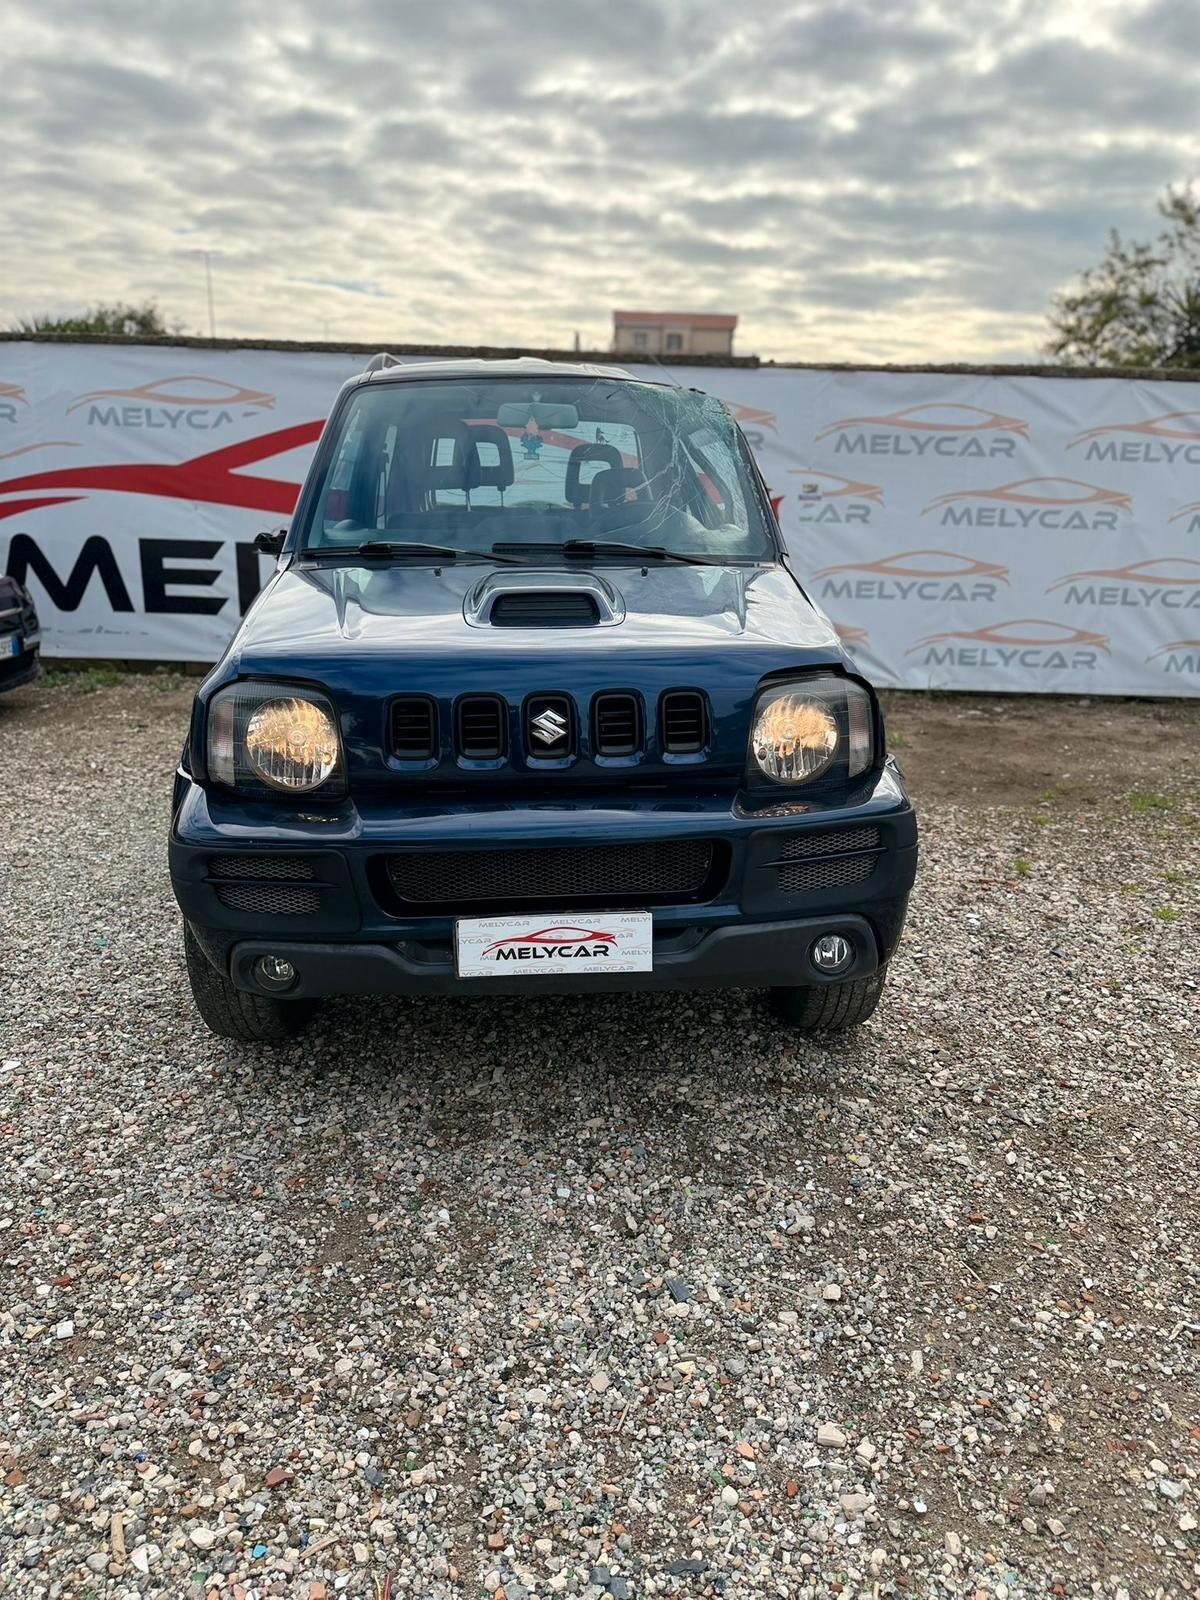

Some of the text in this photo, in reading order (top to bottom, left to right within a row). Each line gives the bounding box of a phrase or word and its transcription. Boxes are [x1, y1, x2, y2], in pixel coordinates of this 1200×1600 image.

[88, 406, 258, 429] MELYCA
[834, 433, 1016, 458] MELYCAR
[940, 507, 1118, 531] MELYCAR
[822, 580, 998, 603] MELYCAR
[924, 647, 1098, 670] MELYCAR
[478, 920, 530, 928] MELYCAR
[495, 944, 610, 961] MELYCAR
